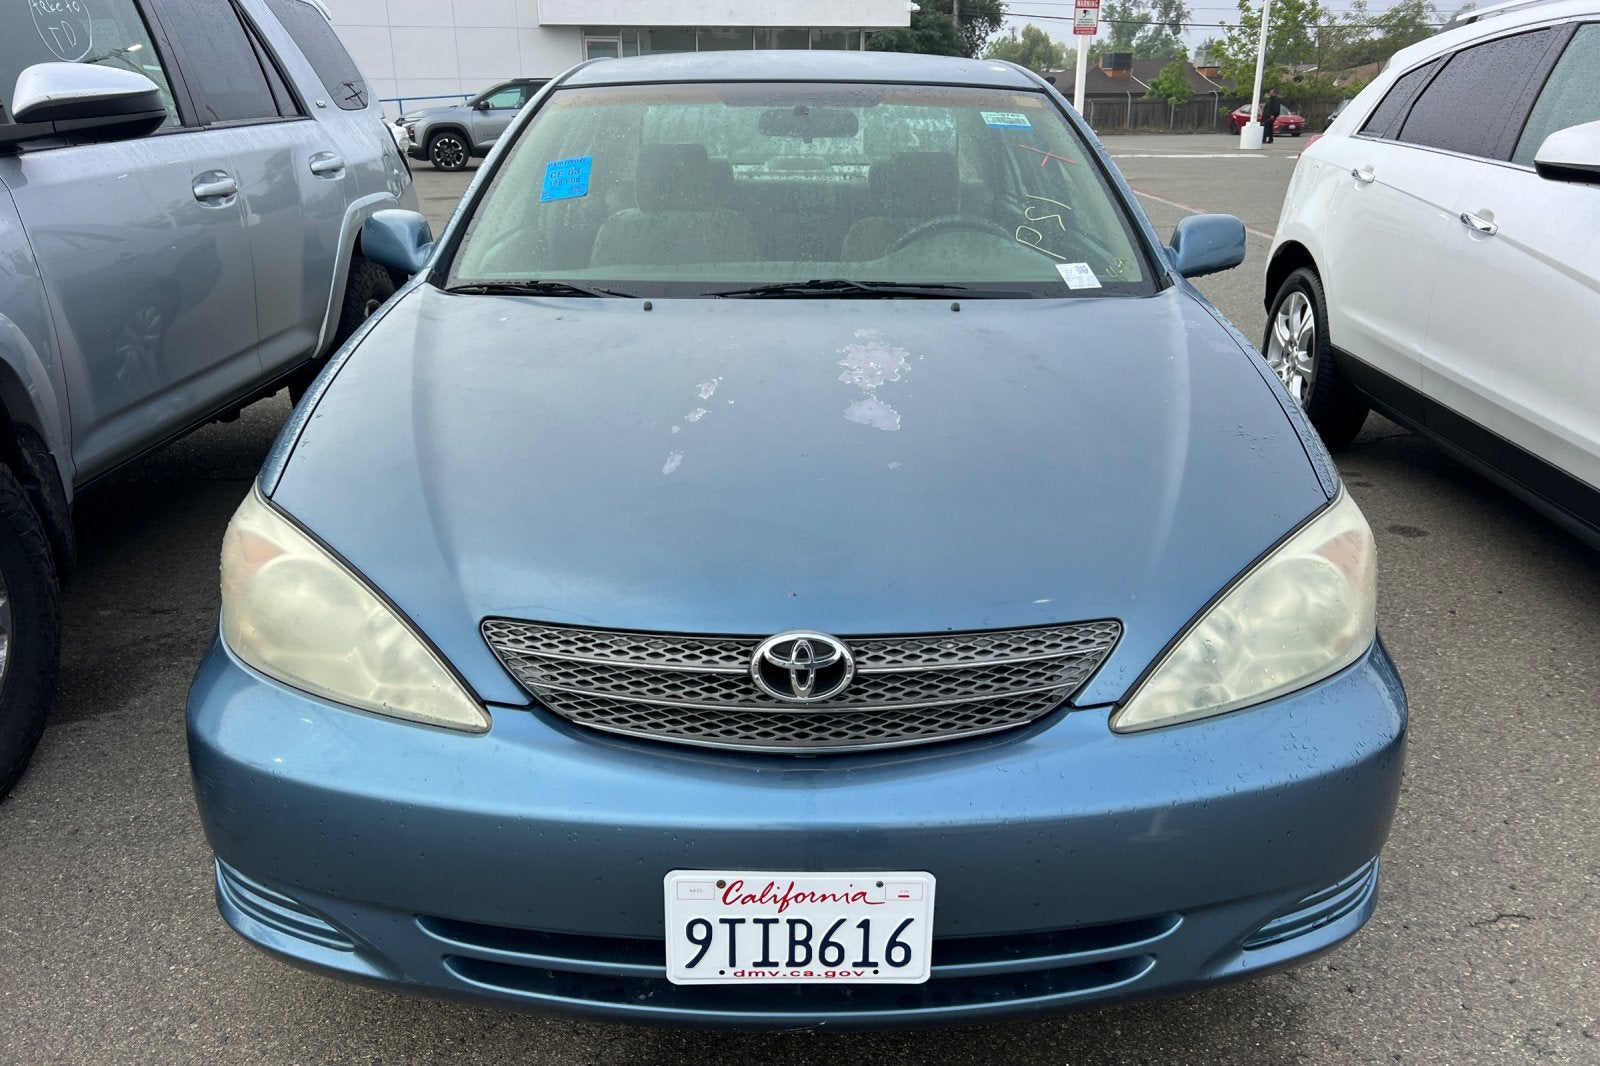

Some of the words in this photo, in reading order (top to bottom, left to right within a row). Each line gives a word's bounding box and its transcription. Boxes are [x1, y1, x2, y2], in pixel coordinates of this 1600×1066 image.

[47, 20, 76, 53] TD
[721, 880, 886, 913] California
[685, 917, 915, 969] 9TIB616
[733, 969, 866, 979] dmv.ca.gov
